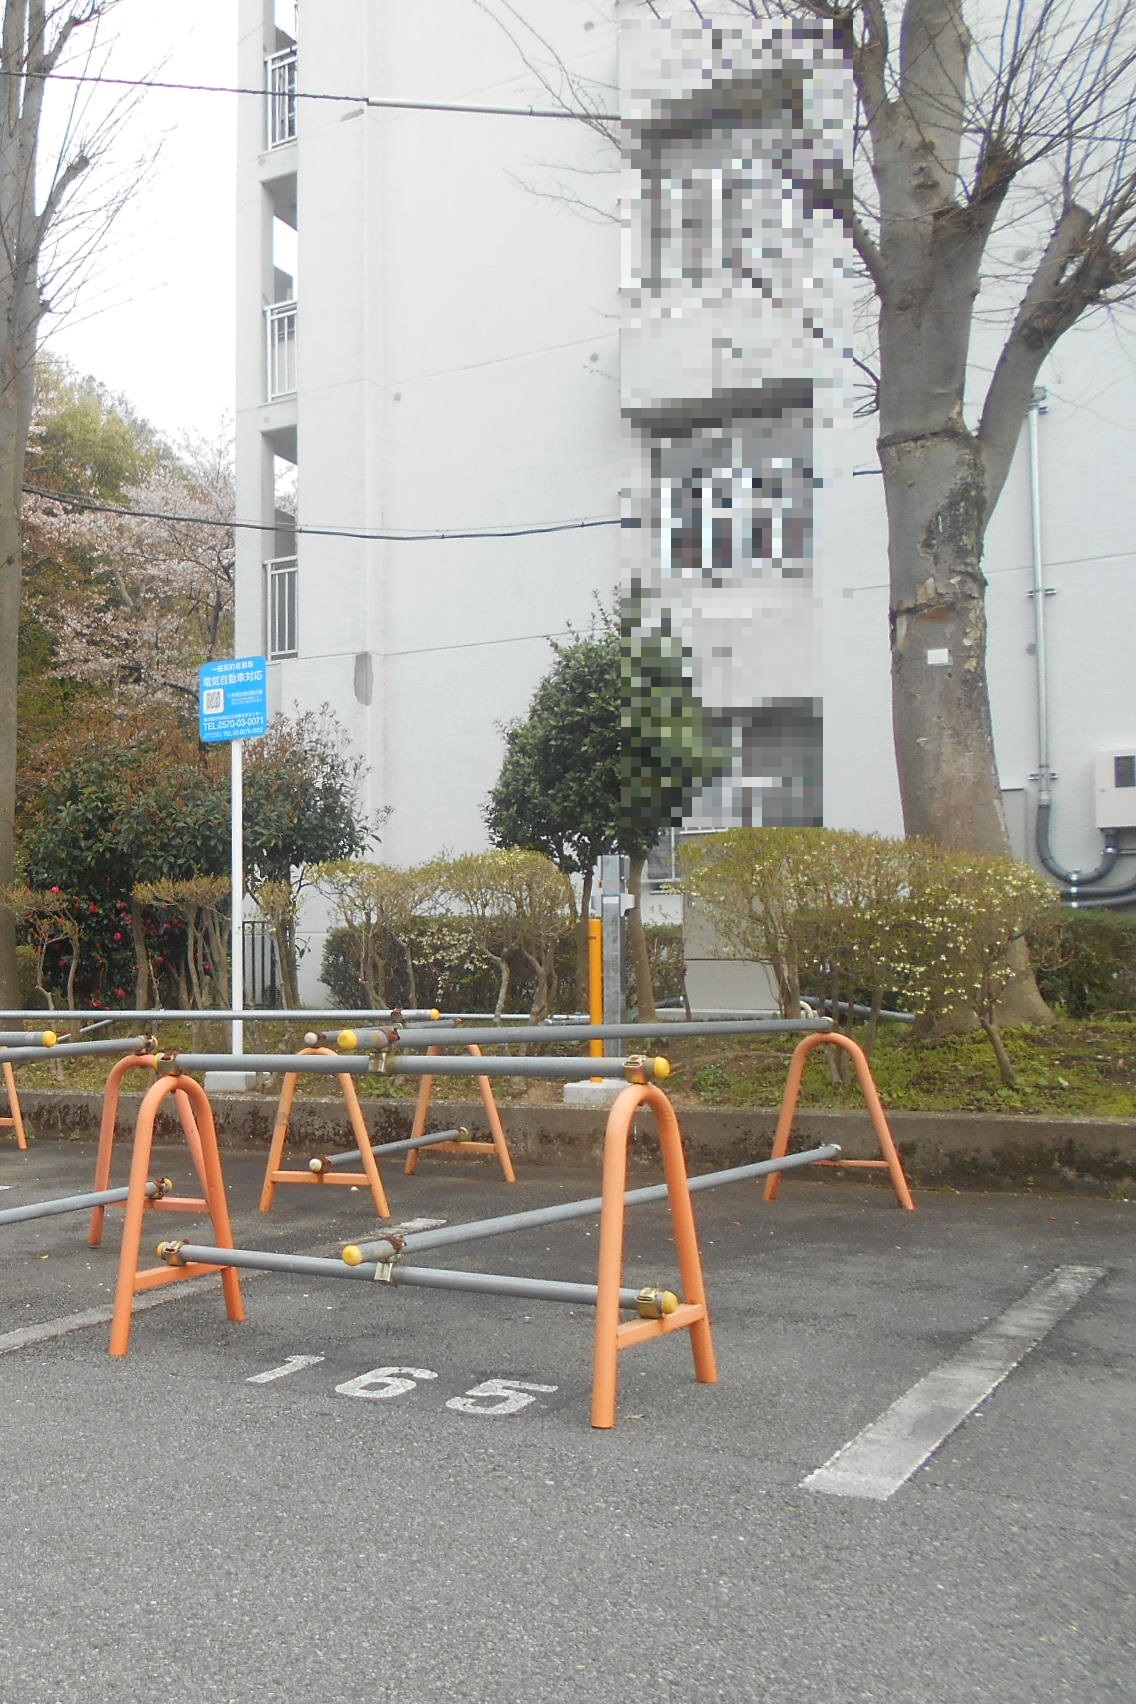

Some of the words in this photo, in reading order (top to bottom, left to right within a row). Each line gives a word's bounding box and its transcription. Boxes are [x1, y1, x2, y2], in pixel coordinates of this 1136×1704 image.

[203, 671, 262, 686] 電気自動車対応
[246, 1354, 559, 1415] 165
